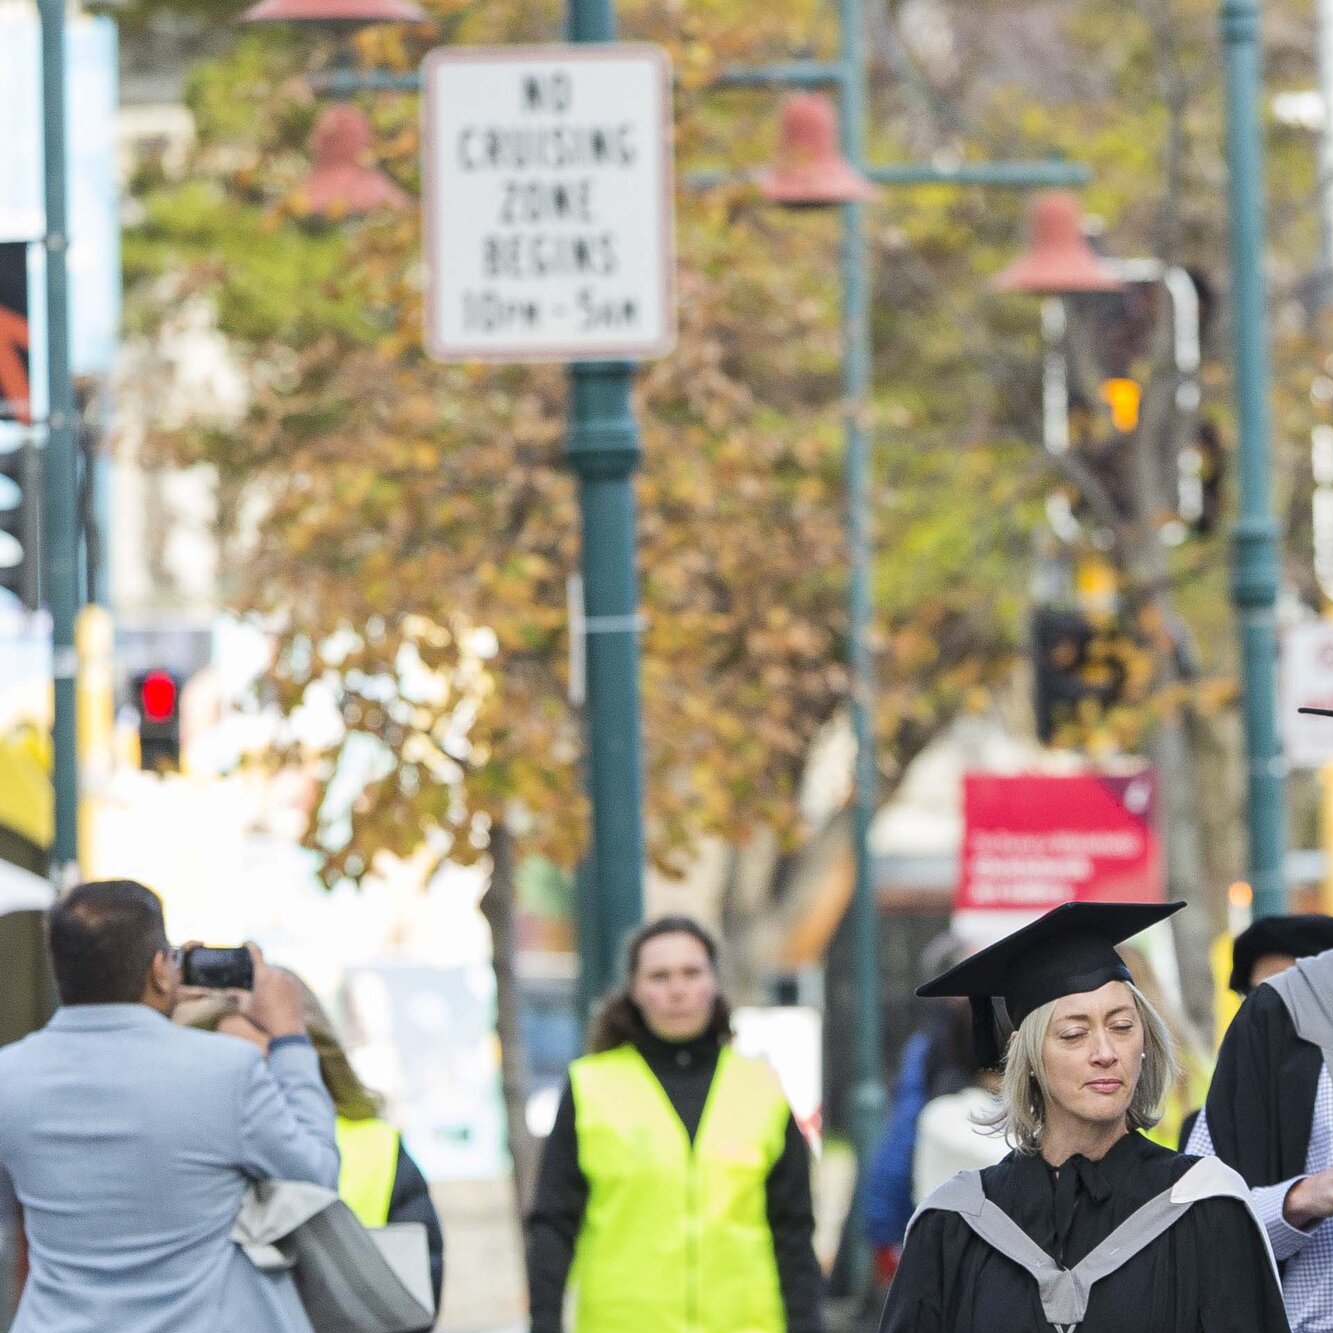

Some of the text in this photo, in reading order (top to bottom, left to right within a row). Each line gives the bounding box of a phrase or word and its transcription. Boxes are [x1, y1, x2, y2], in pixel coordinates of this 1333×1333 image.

[521, 73, 573, 113] NO
[459, 126, 636, 172] CRUISING
[500, 179, 592, 224] ZONE
[482, 231, 620, 280] BEGINS
